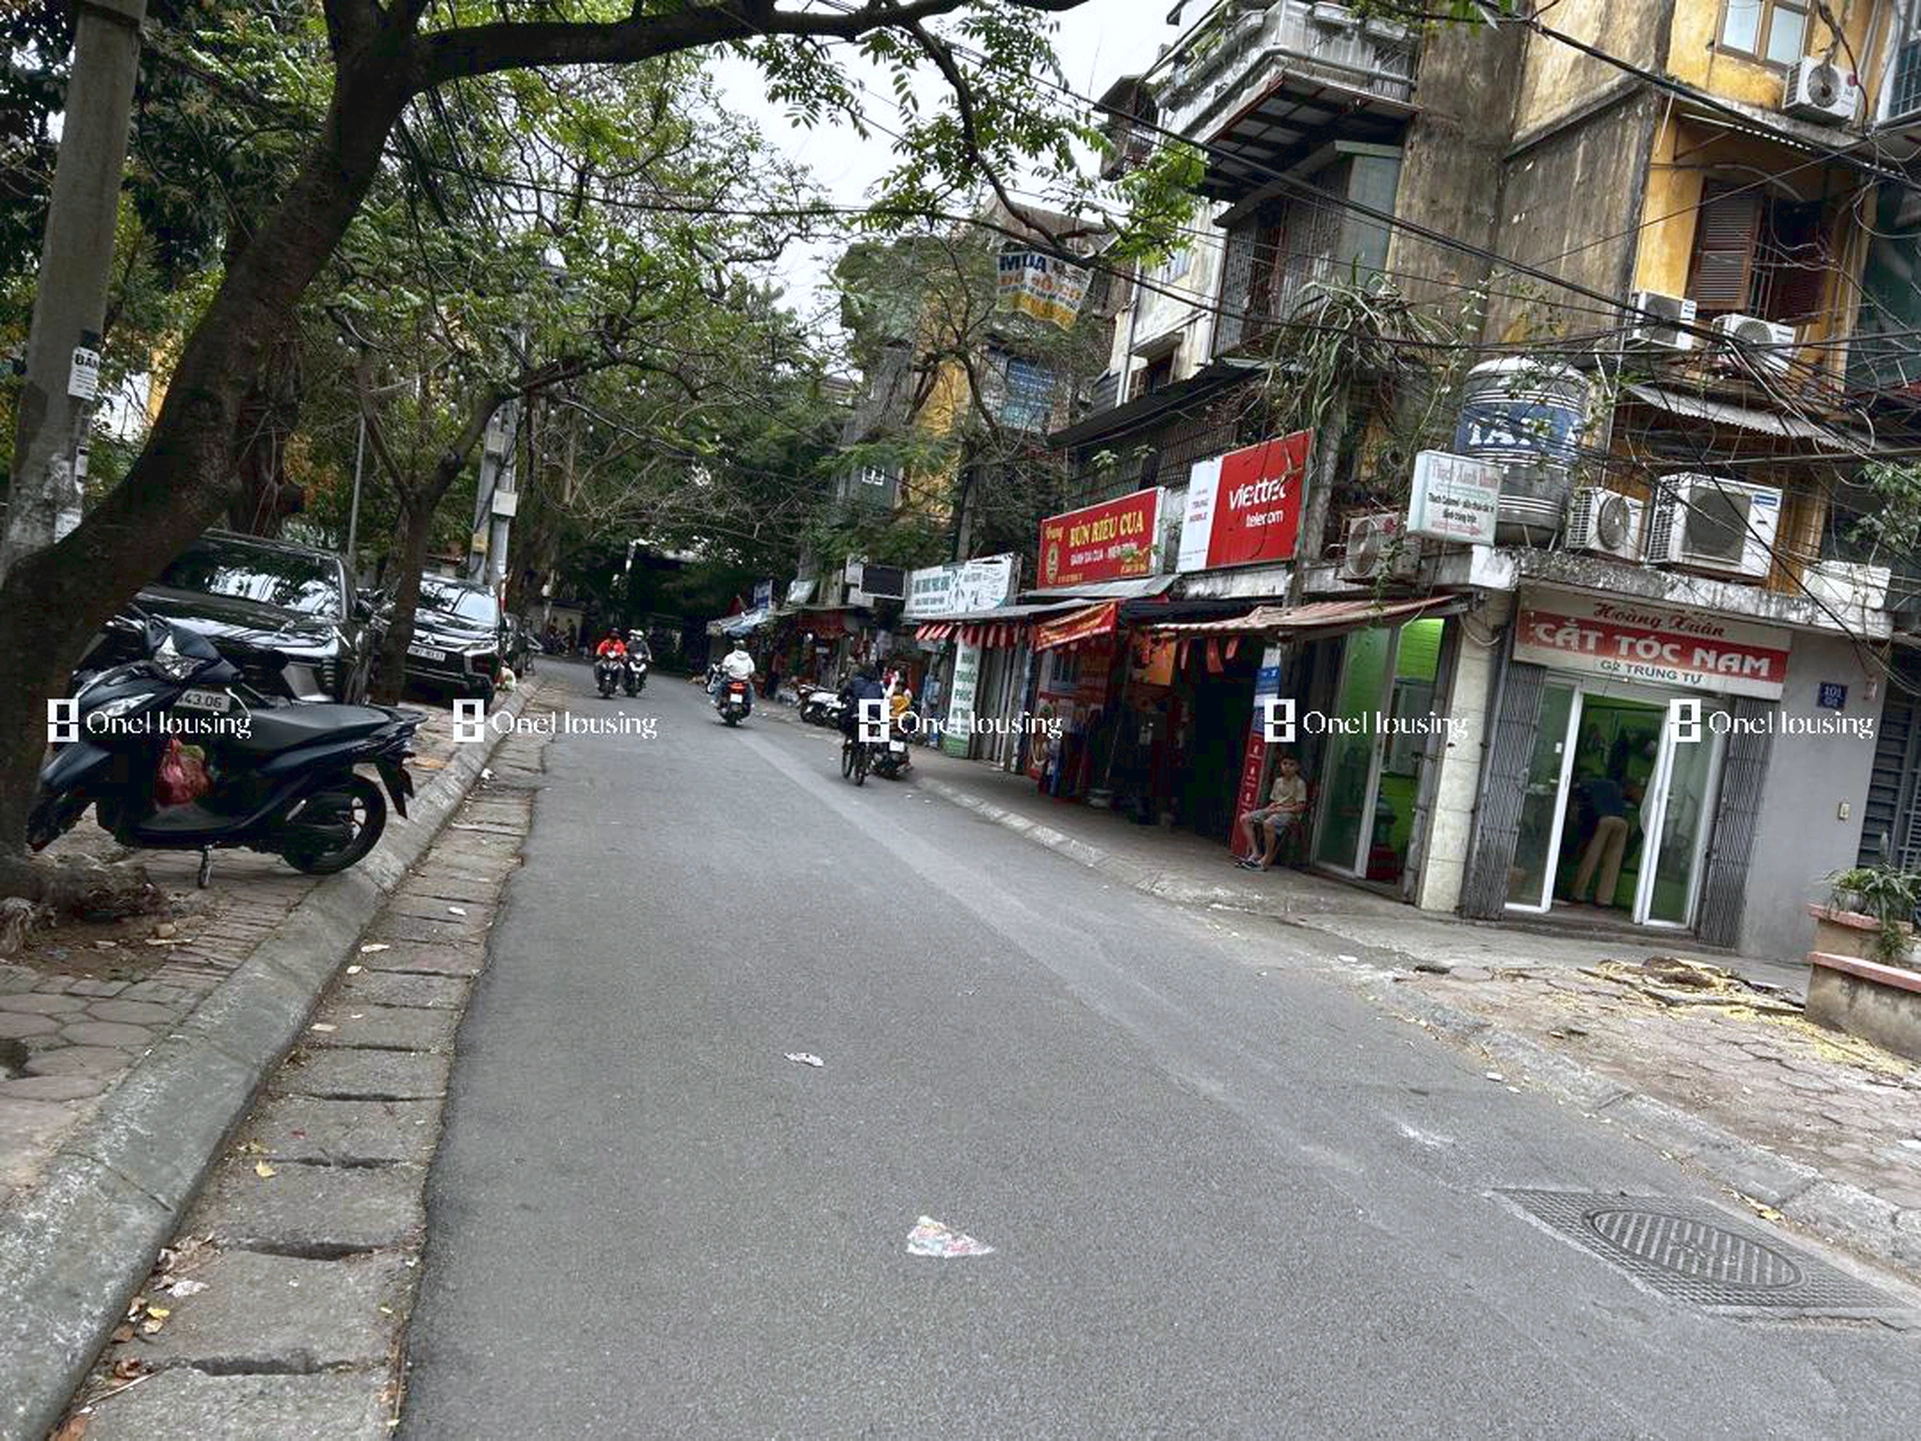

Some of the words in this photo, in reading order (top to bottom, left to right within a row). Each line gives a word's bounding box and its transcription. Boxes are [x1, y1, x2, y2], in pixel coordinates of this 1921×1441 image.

[999, 254, 1047, 273] MUA
[1120, 509, 1145, 536] CUA
[1593, 601, 1661, 629] Hoàng
[1667, 613, 1726, 638] Xuân
[1532, 617, 1604, 653] CẮT
[1613, 633, 1682, 662] TÓC
[1692, 647, 1771, 677] NAM
[1625, 664, 1678, 681] TRUNG
[1682, 671, 1704, 685] TỰ
